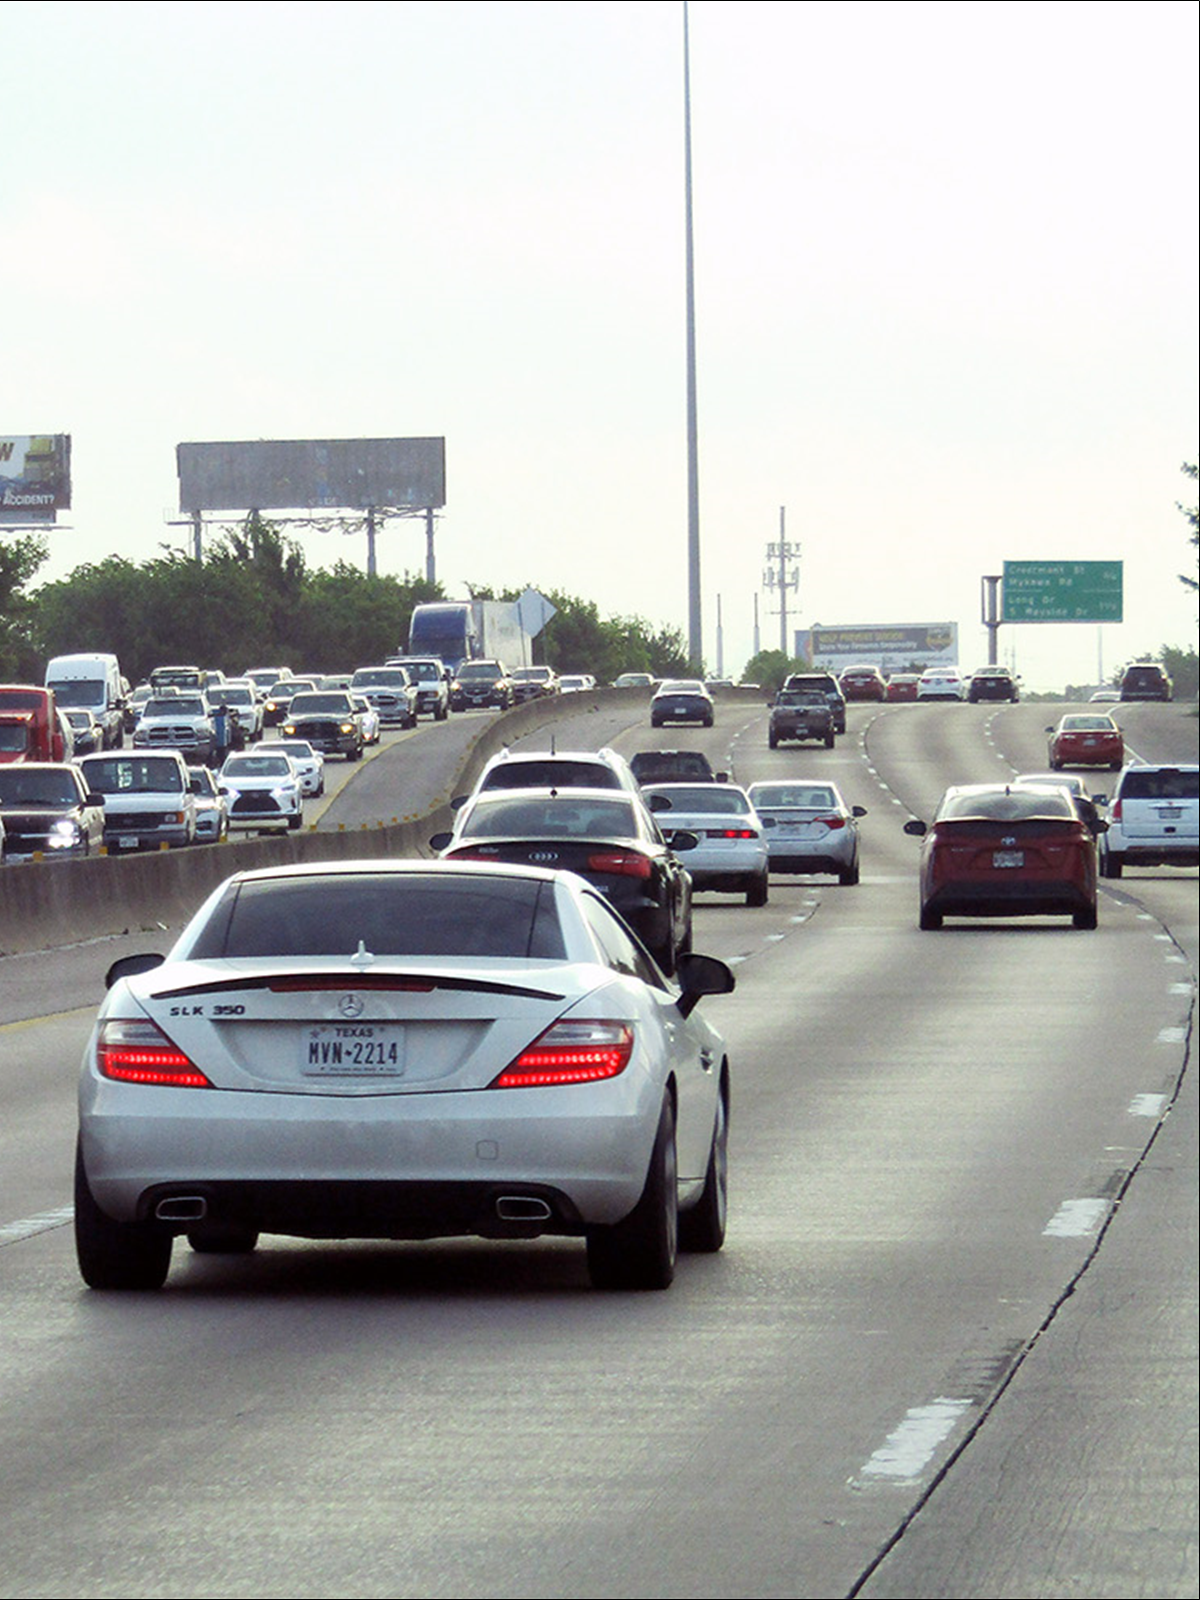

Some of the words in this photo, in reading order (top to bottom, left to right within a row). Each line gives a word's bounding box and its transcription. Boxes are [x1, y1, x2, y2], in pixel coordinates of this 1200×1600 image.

[3, 494, 55, 506] ACCIDENT?
[169, 1006, 204, 1017] SLK
[212, 1004, 246, 1016] 350
[335, 1027, 375, 1038] TEXAS
